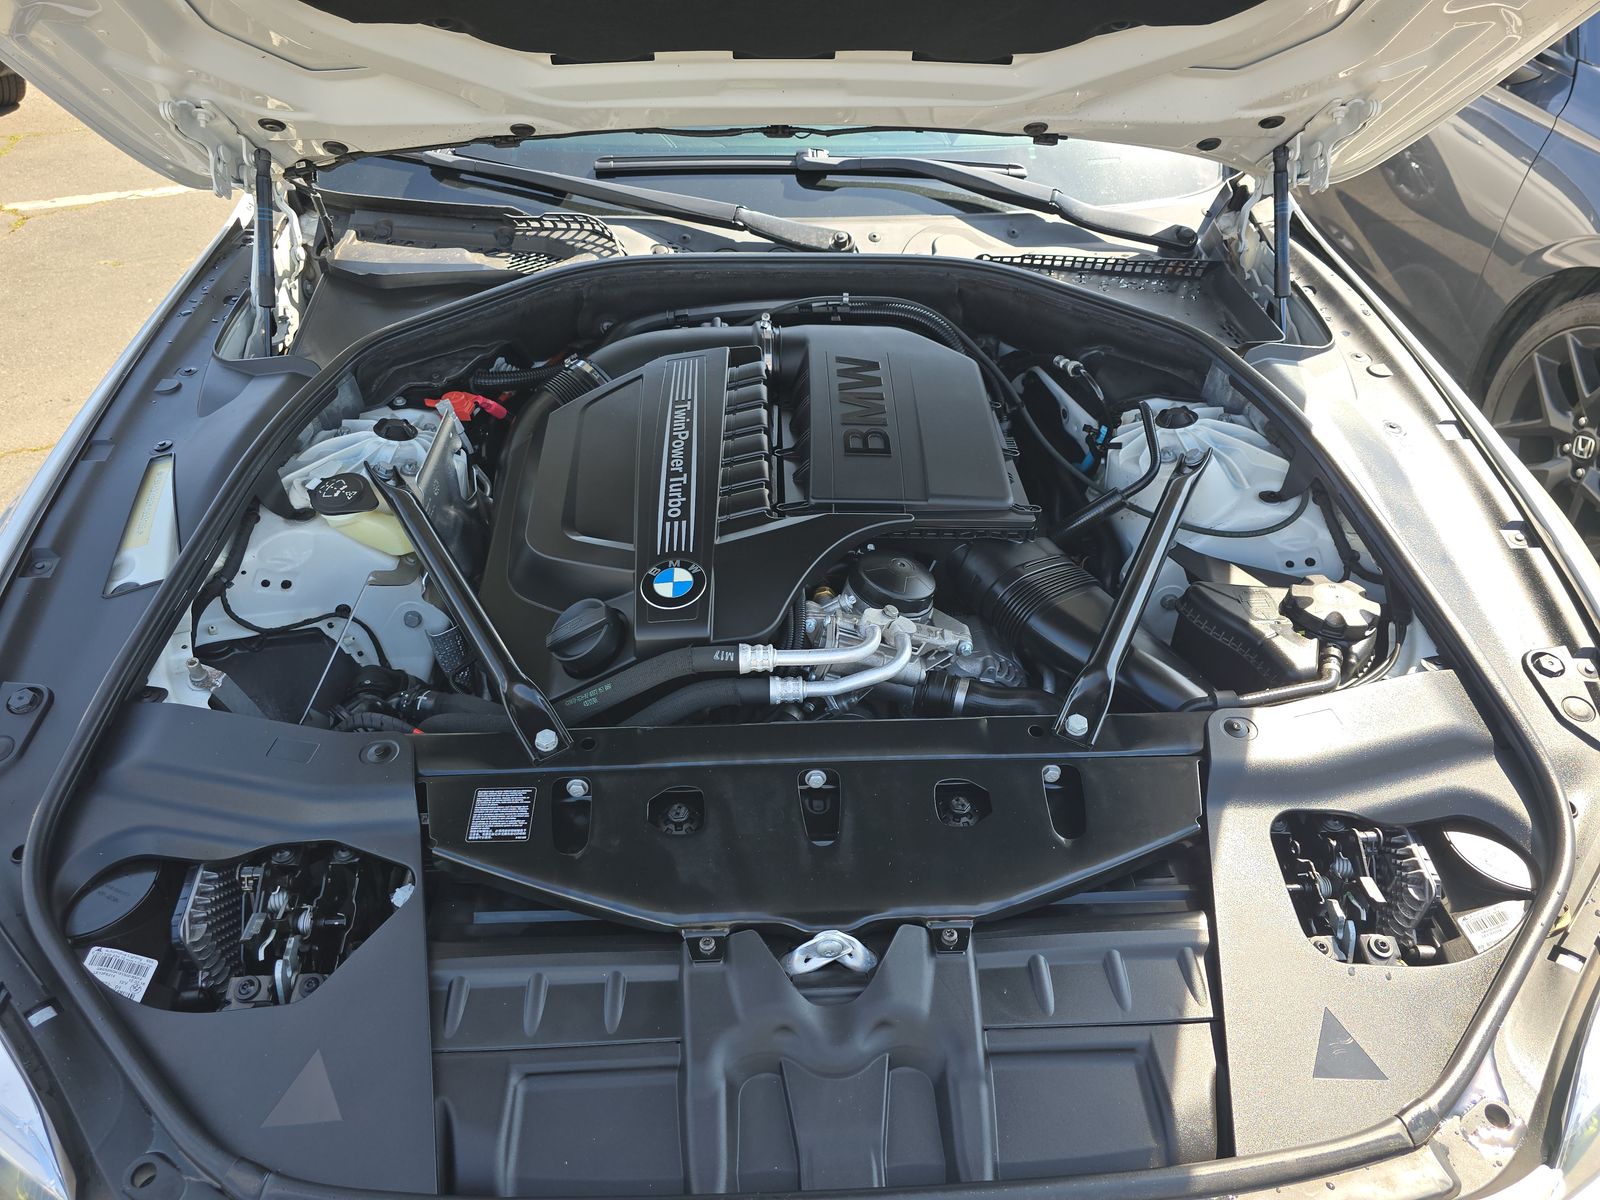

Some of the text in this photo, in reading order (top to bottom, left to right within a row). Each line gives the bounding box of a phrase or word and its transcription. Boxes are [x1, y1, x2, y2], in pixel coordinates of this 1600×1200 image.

[835, 356, 892, 457] BMW
[667, 400, 691, 518] TwinPower Turbo
[648, 559, 701, 577] BMW
